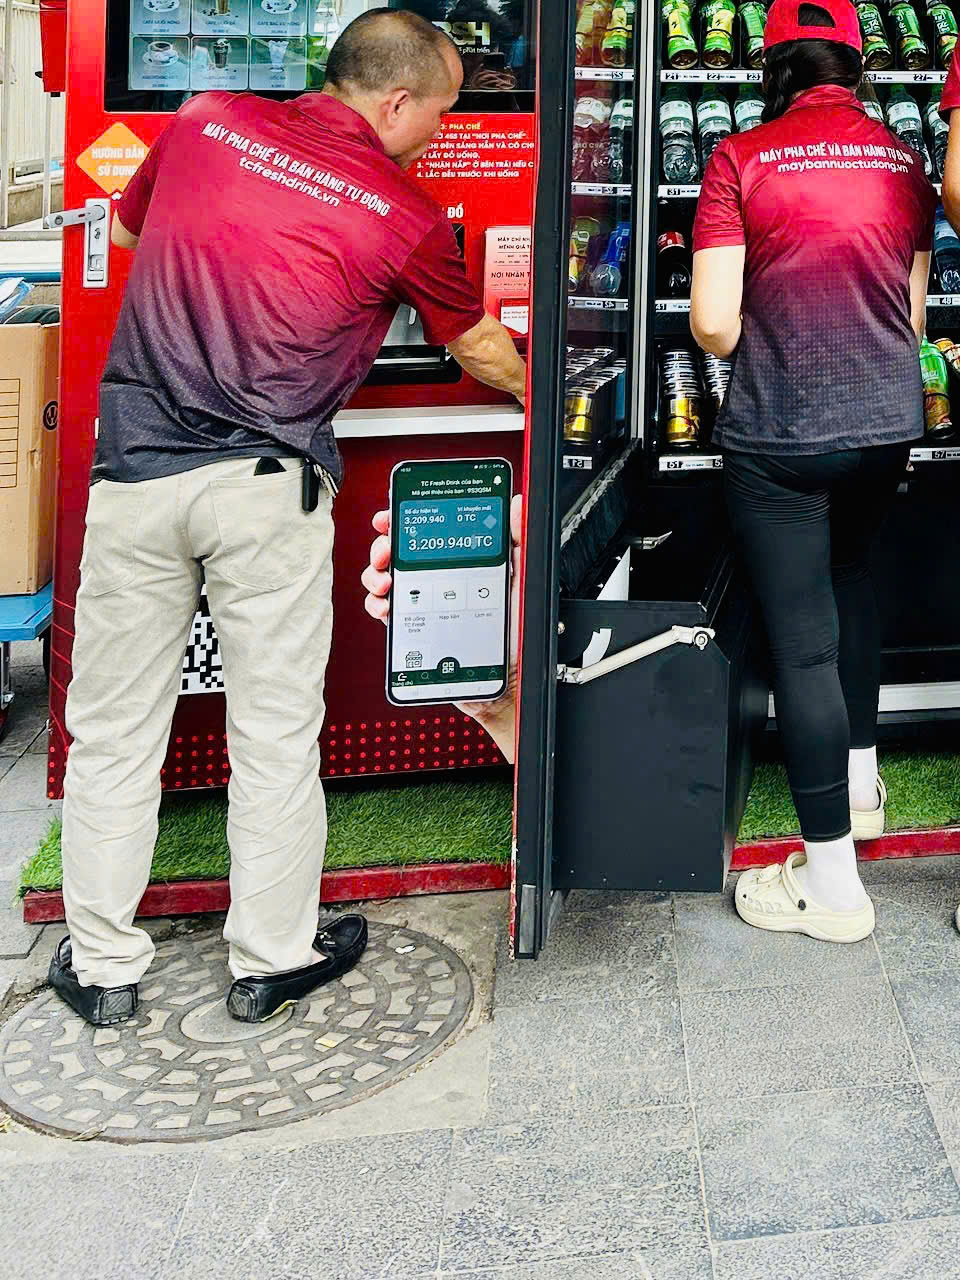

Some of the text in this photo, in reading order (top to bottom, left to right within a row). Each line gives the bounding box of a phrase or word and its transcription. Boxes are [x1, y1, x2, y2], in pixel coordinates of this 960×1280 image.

[466, 121, 481, 130] CHẾ
[456, 140, 477, 149] SÁNG
[760, 148, 782, 164] MÁY
[784, 145, 805, 159] PHA
[806, 141, 827, 157] CHẾ
[827, 142, 840, 157] VÀ
[843, 143, 863, 158] BÁN
[863, 143, 887, 158] HÀNG
[202, 122, 392, 218] MÁY PHA CHẾ VÀ BÁN HÀNG TỰ ĐỘNG
[238, 156, 341, 208] tcfreshdrink.vn
[932, 451, 946, 459] 57
[667, 460, 682, 469] 51
[430, 479, 445, 487] Fresh
[404, 513, 477, 525] 3.209.940 0 TC
[404, 526, 417, 534] TC
[408, 535, 493, 551] 3.209.940 TC
